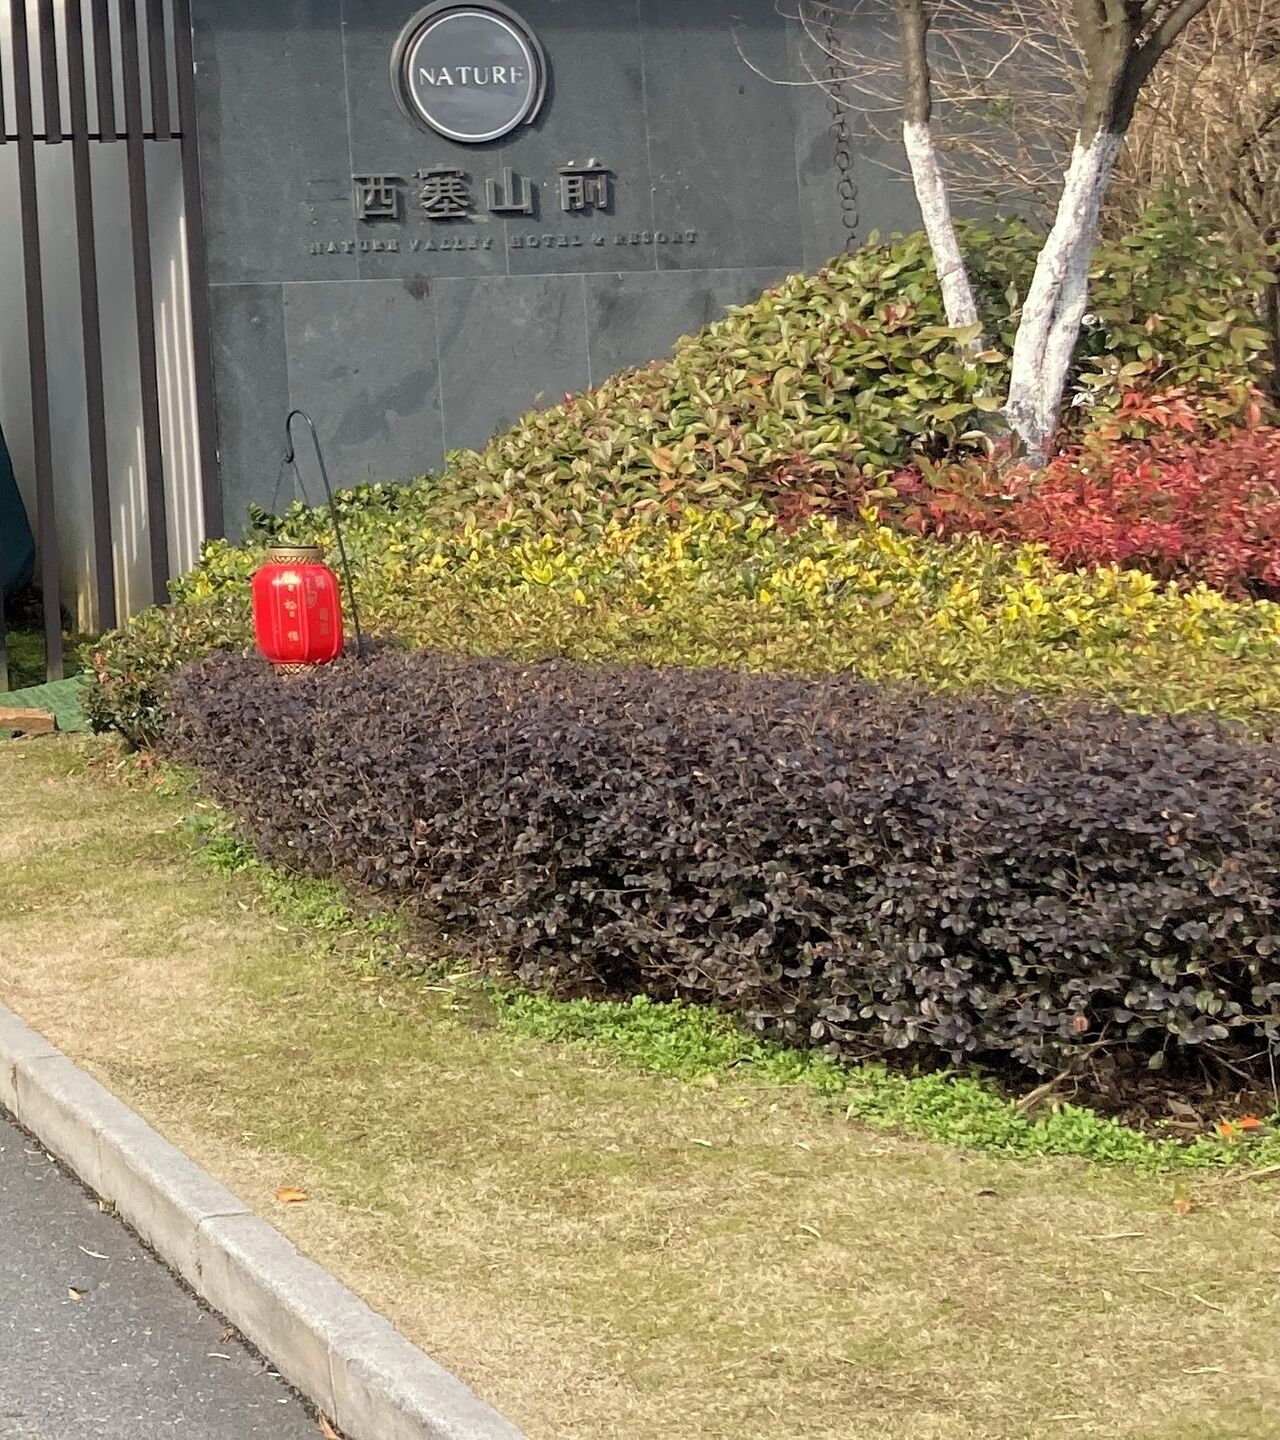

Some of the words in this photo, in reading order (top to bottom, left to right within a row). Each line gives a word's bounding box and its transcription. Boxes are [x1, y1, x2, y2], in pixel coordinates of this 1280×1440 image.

[419, 64, 526, 86] NATURE
[352, 157, 612, 221] 西塞山前
[309, 240, 400, 256] NATURE
[408, 236, 495, 253] VALLEY
[508, 233, 583, 249] HOTEL
[613, 229, 700, 246] RESORT
